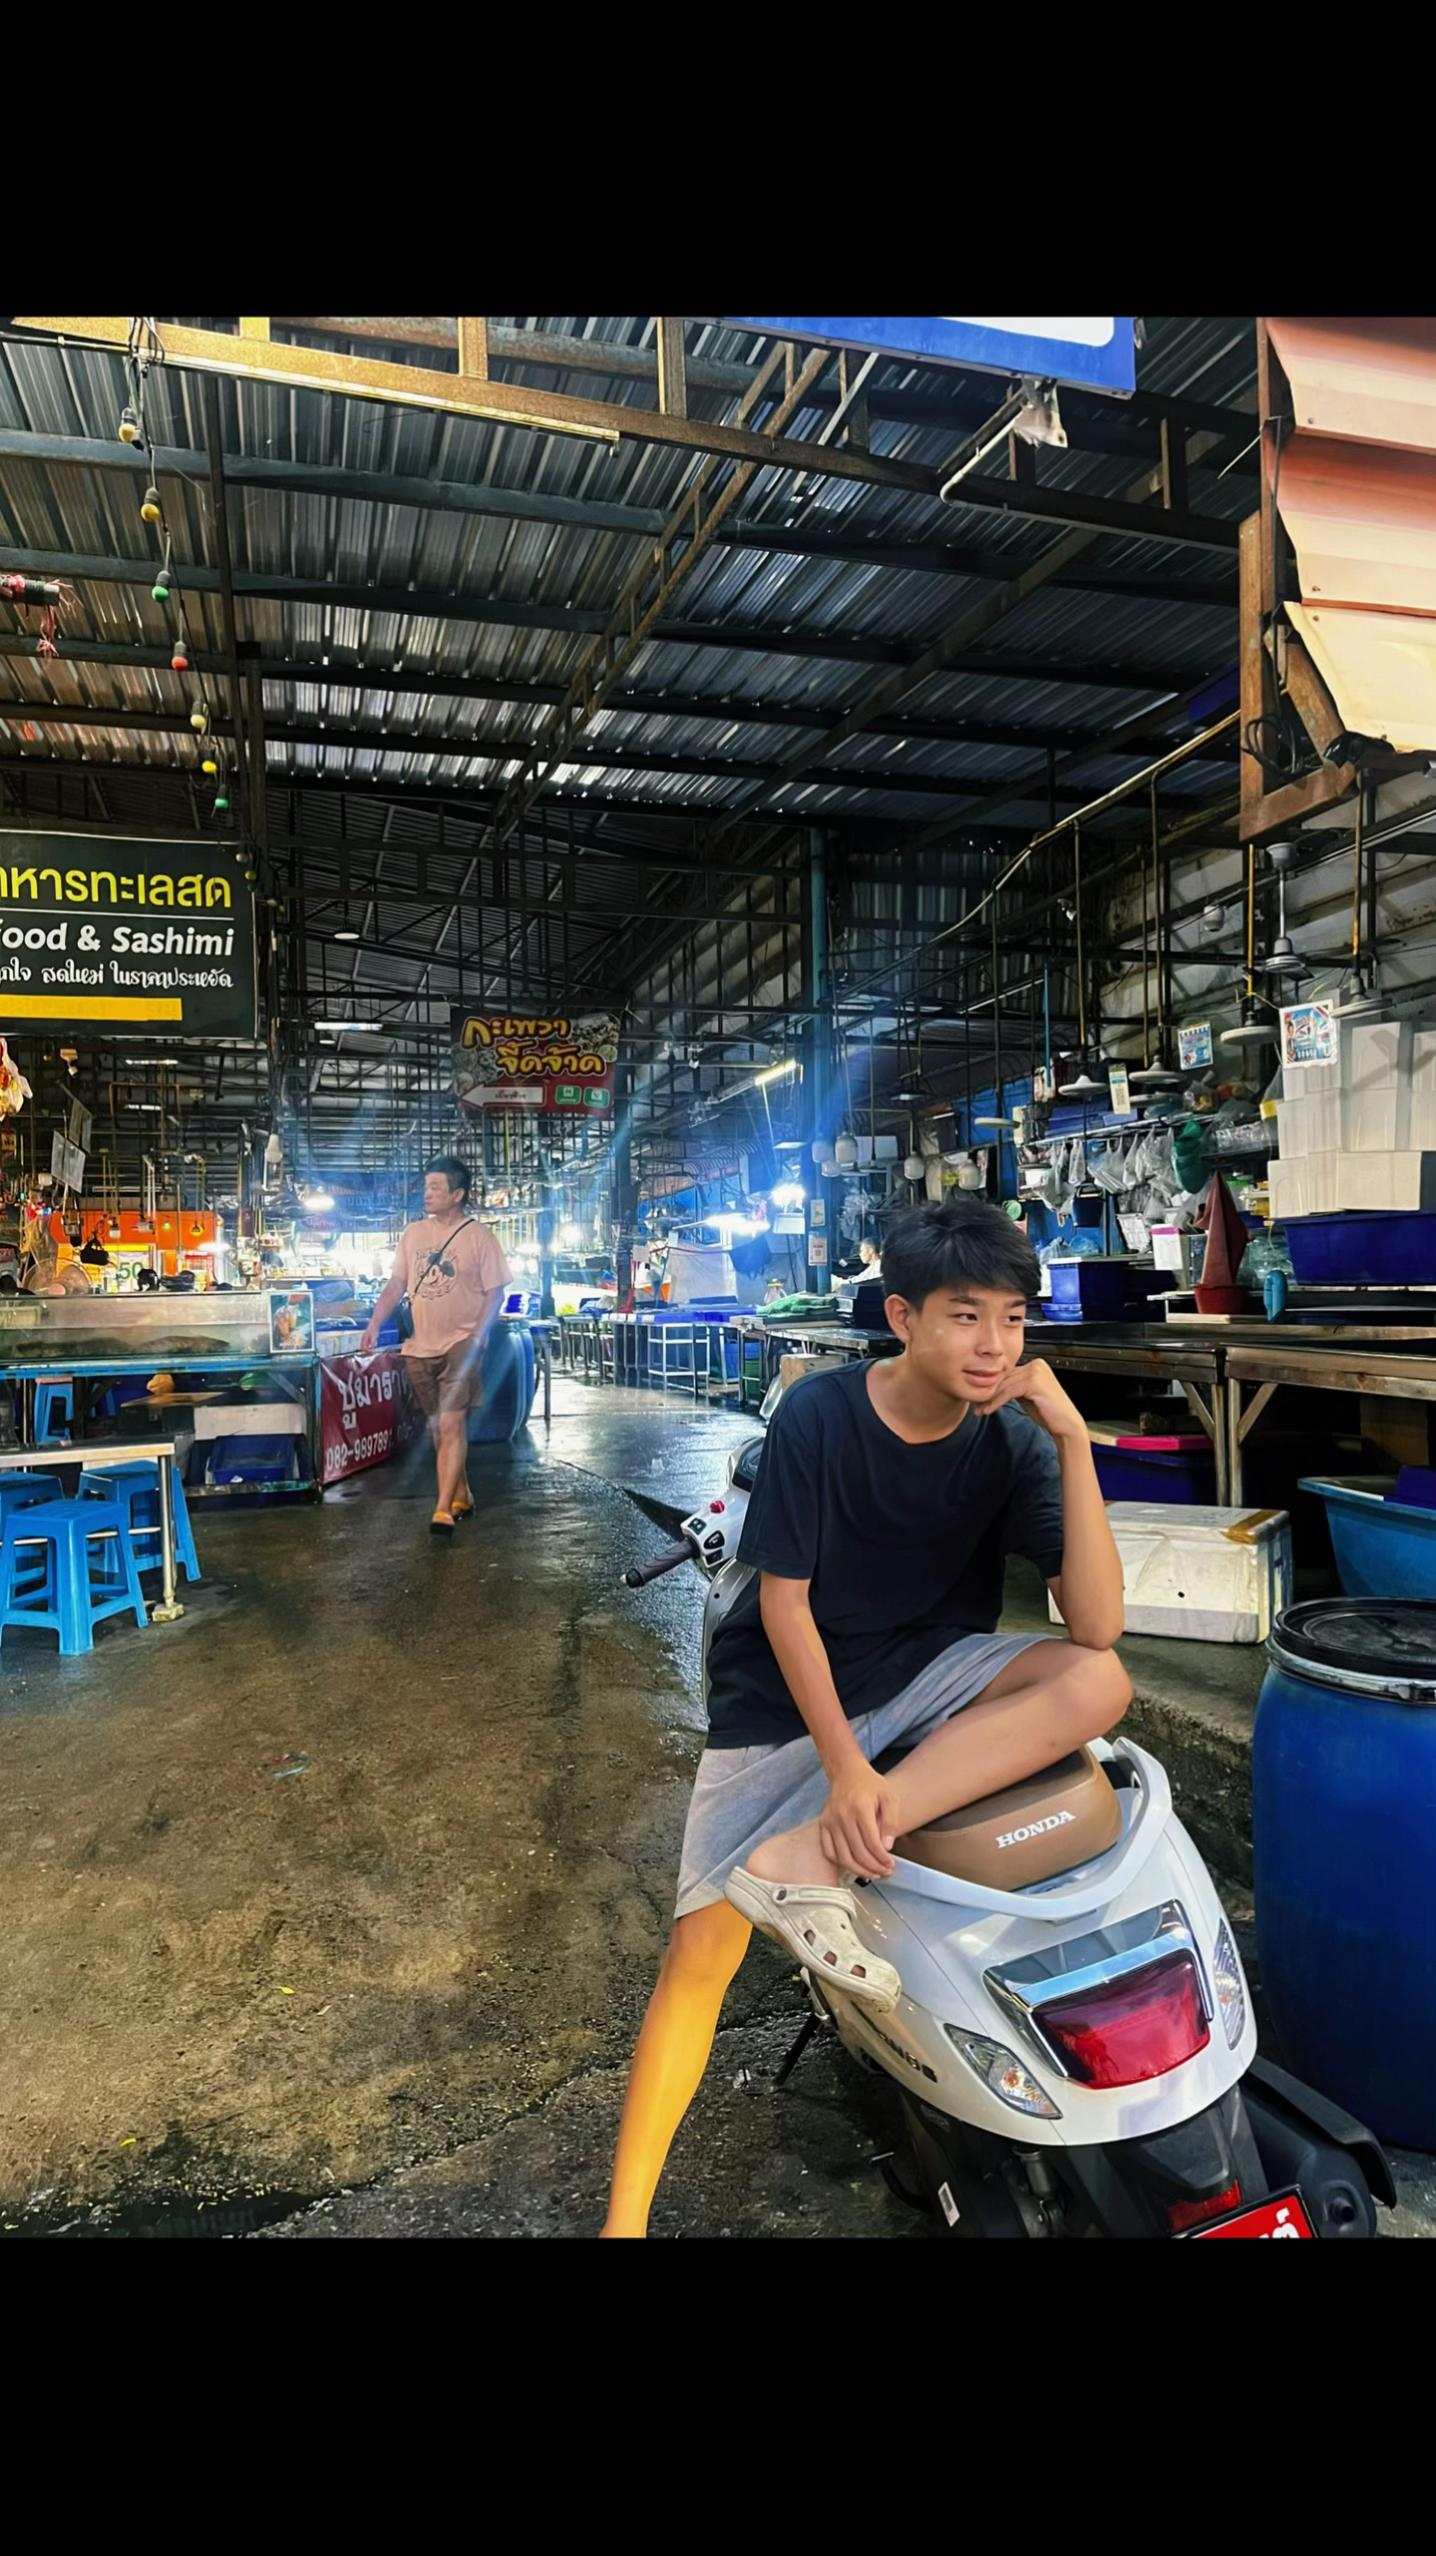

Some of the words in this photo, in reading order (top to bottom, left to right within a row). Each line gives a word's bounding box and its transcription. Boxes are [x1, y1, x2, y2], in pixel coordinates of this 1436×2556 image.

[77, 924, 101, 952] &
[111, 926, 235, 956] Sashimi
[0, 956, 32, 985] กใจ
[41, 958, 104, 985] สดใหม่
[109, 960, 234, 989] ในราคาประหยัด
[995, 1810, 1076, 1849] HONDA
